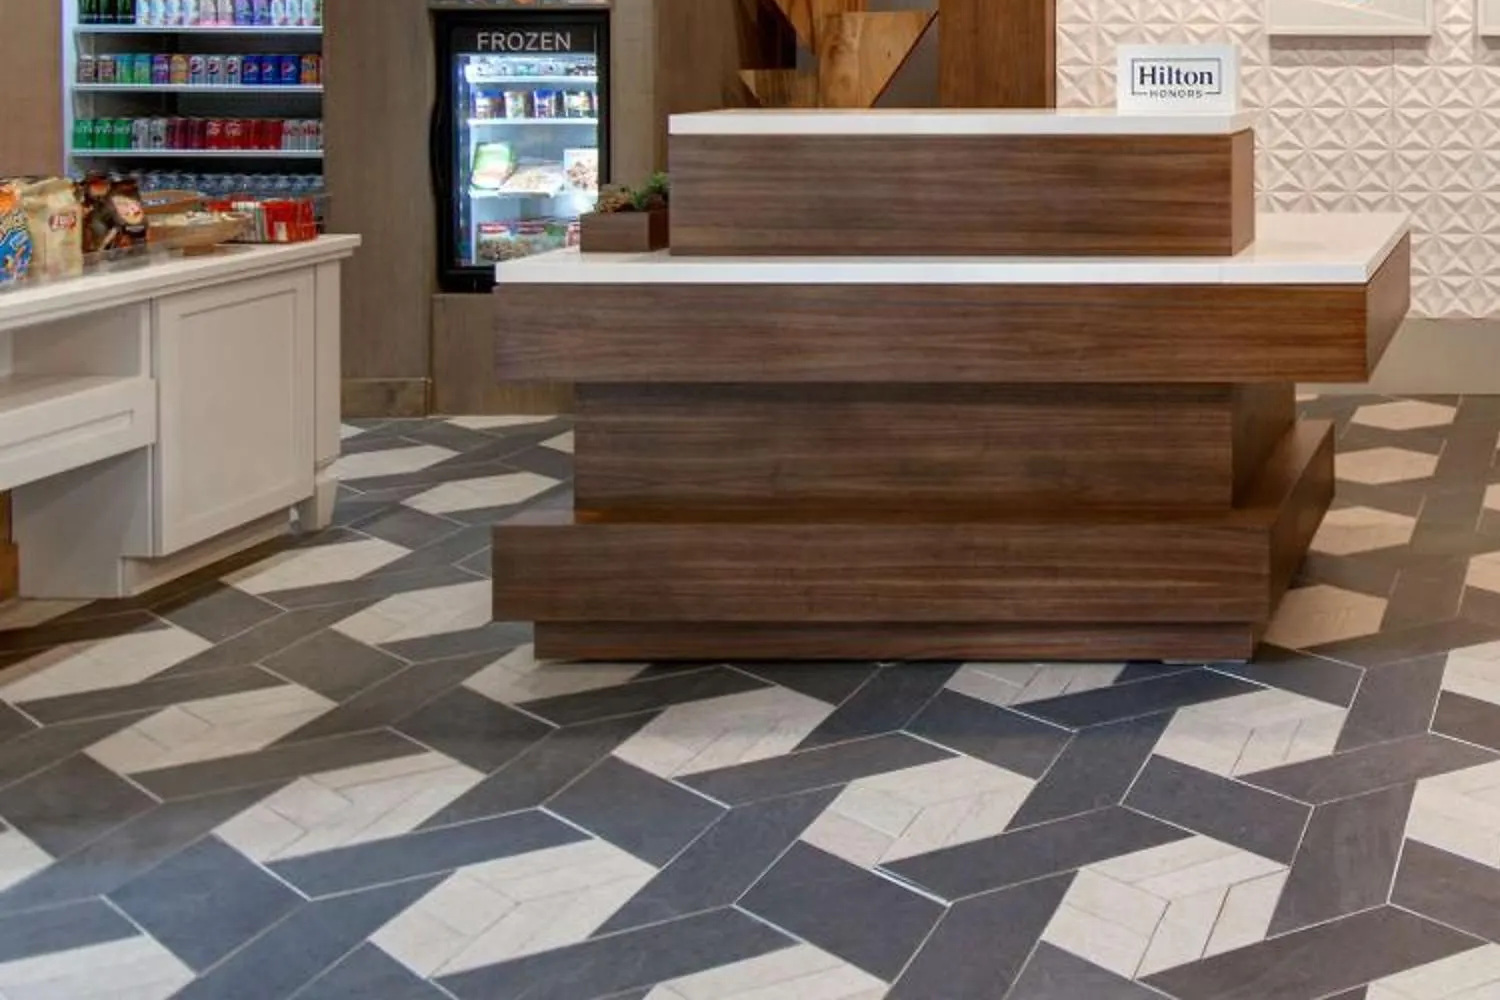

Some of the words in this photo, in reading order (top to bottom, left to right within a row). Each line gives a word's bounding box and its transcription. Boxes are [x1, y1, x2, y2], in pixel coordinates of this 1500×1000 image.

[477, 32, 571, 50] FROZEN
[1139, 66, 1213, 85] Hilton
[1149, 89, 1203, 98] HONORS
